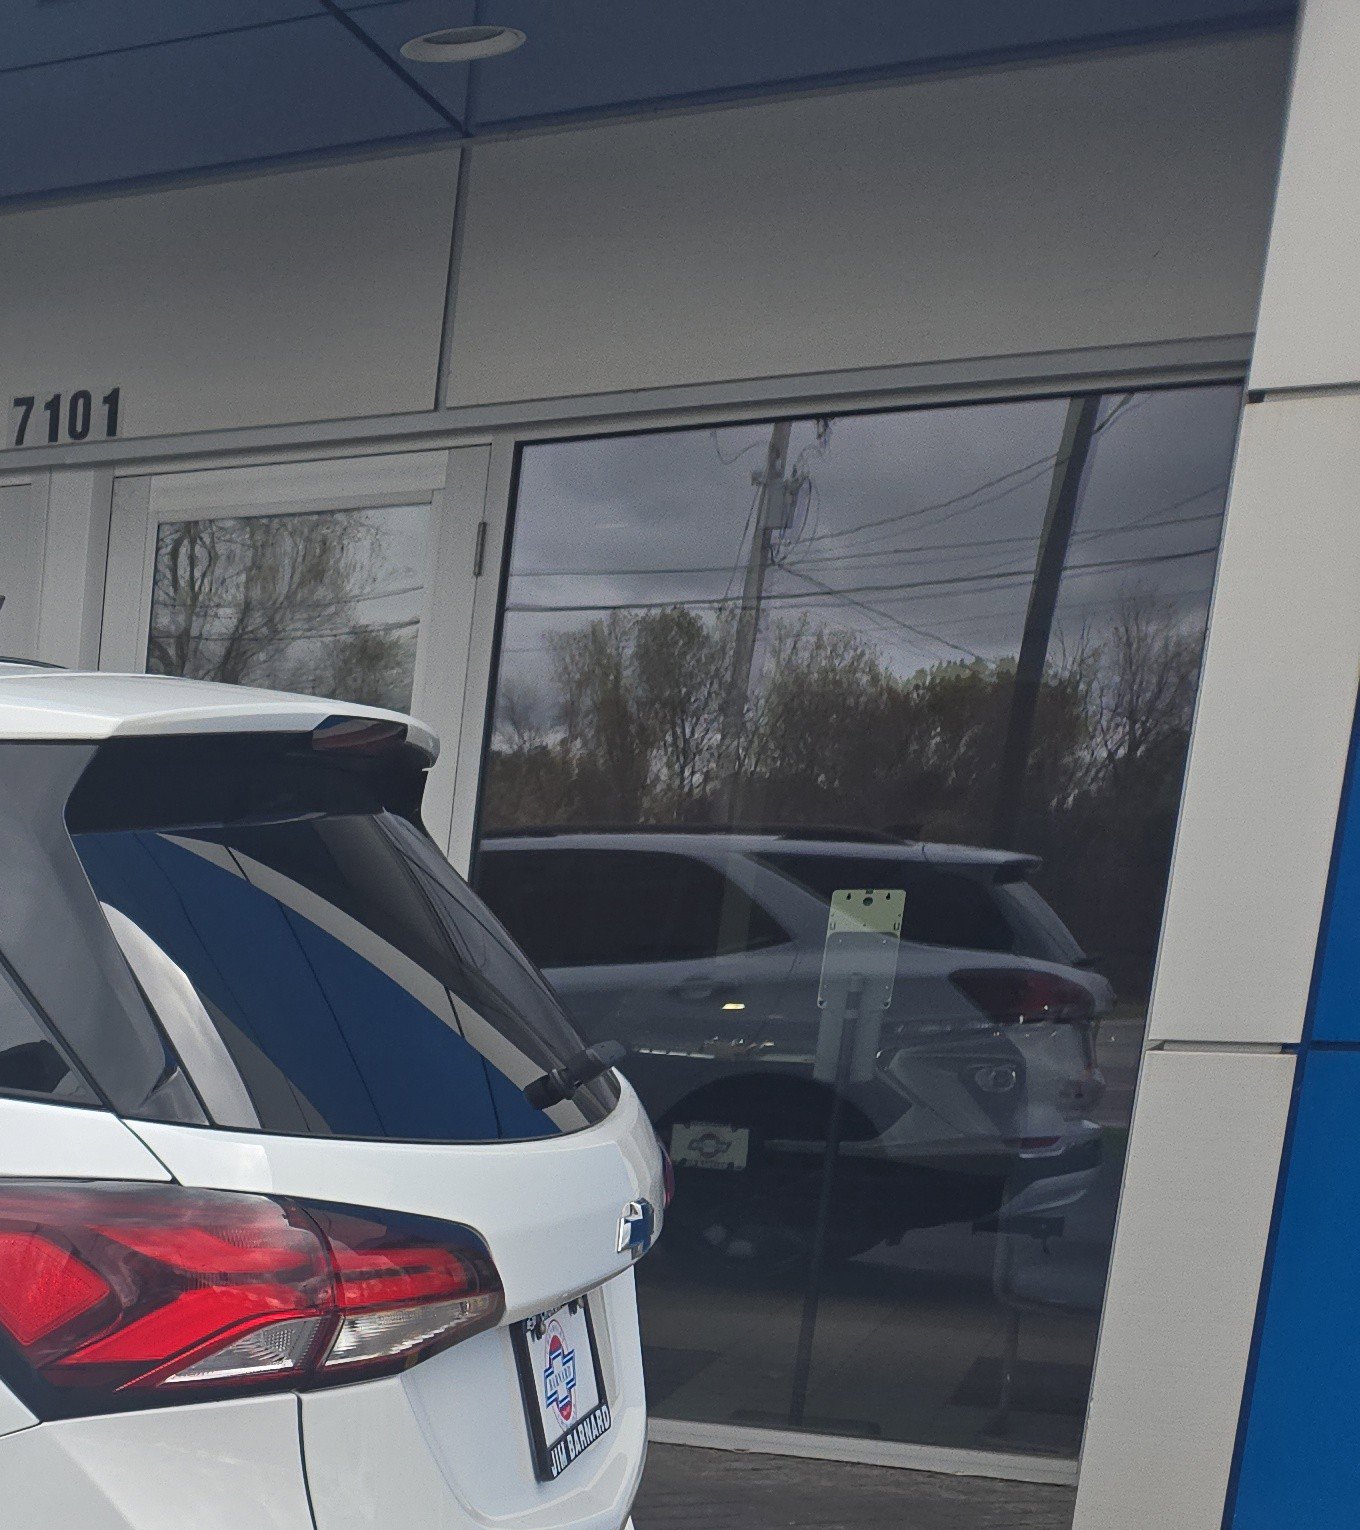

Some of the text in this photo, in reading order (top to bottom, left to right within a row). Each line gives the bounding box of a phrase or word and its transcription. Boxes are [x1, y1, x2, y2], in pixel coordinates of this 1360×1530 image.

[13, 386, 121, 446] 7101
[551, 1405, 611, 1478] JIM BARNARD
